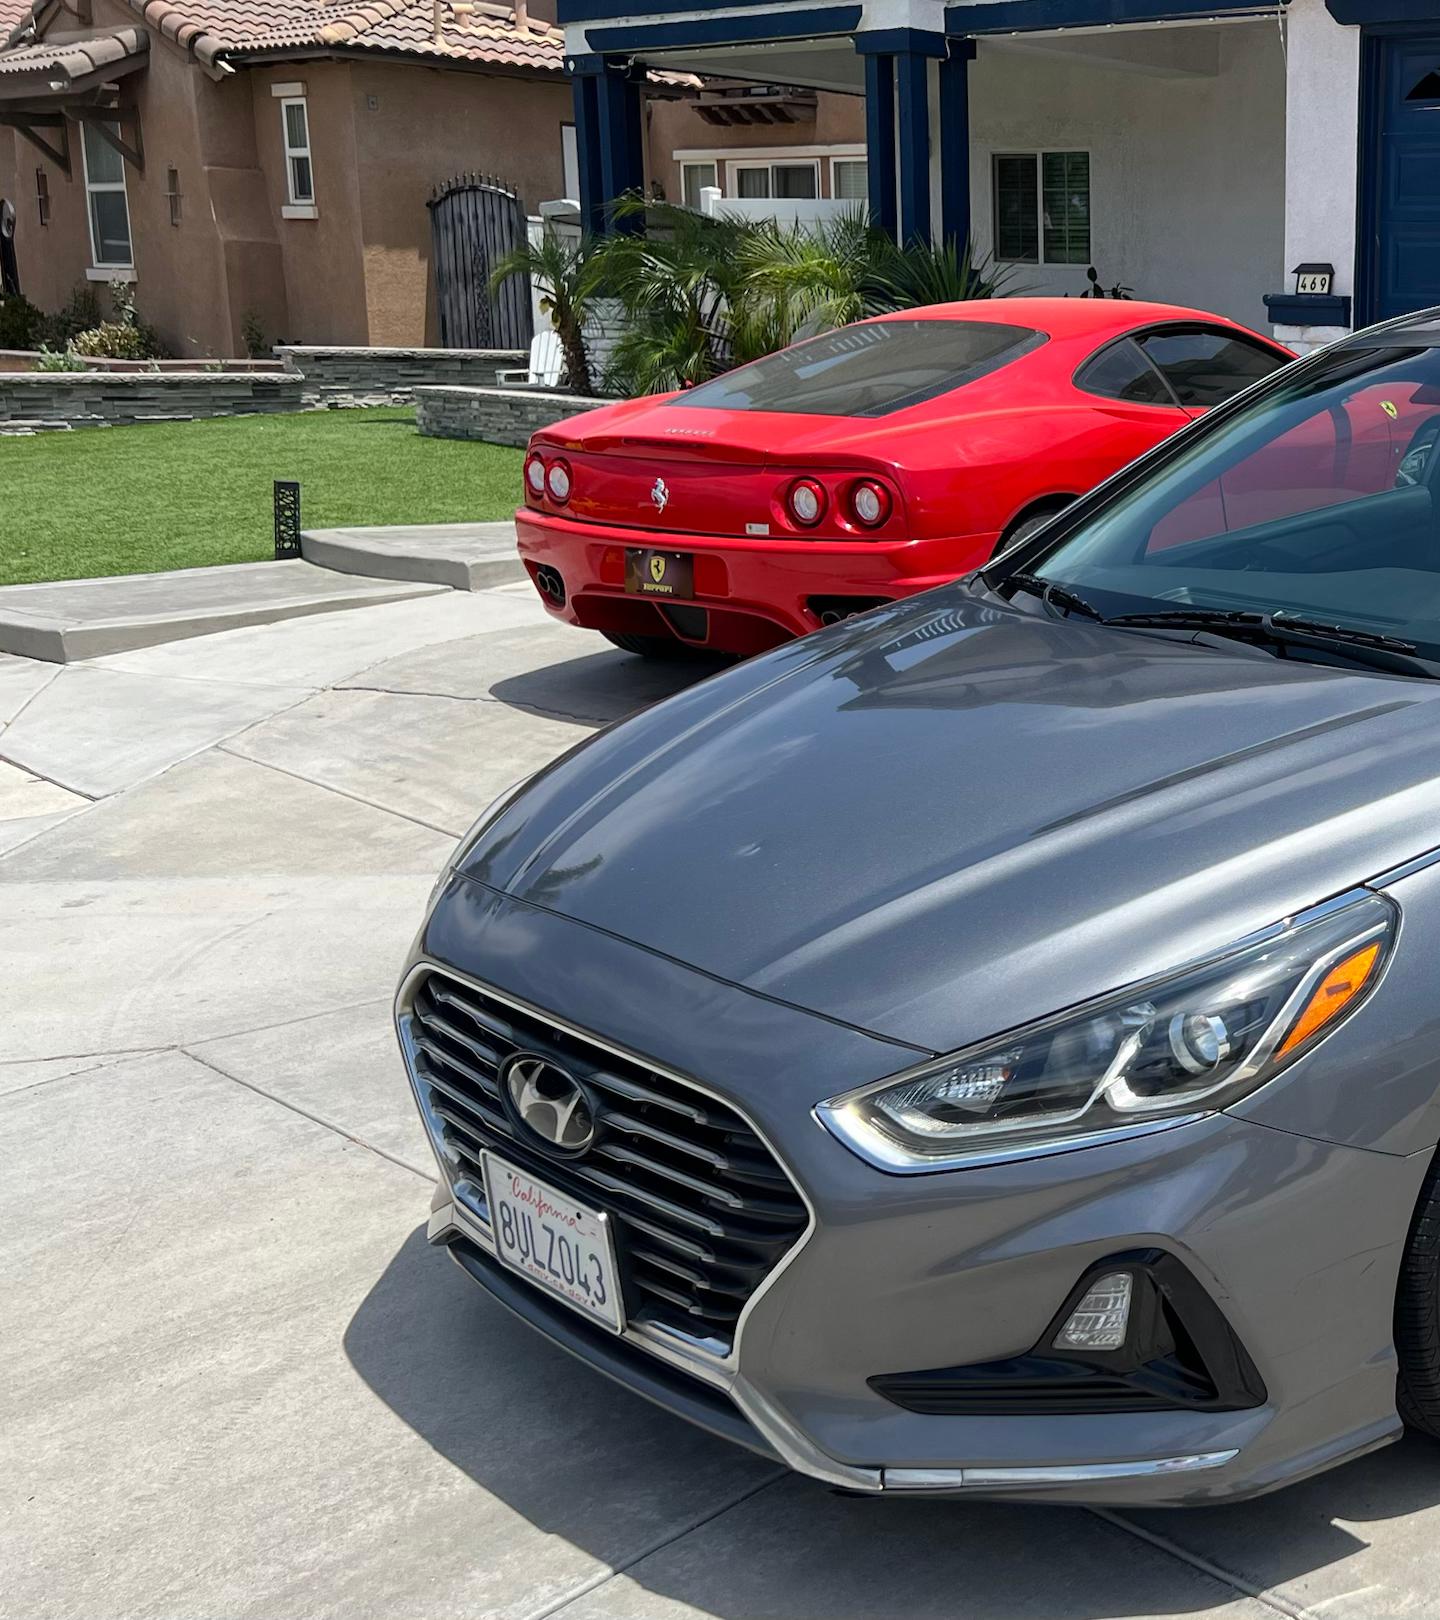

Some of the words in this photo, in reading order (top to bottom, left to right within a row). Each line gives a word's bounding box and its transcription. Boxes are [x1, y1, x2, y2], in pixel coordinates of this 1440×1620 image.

[1300, 277, 1327, 291] 469
[512, 1176, 585, 1236] California
[499, 1200, 606, 1305] 8ULZ043
